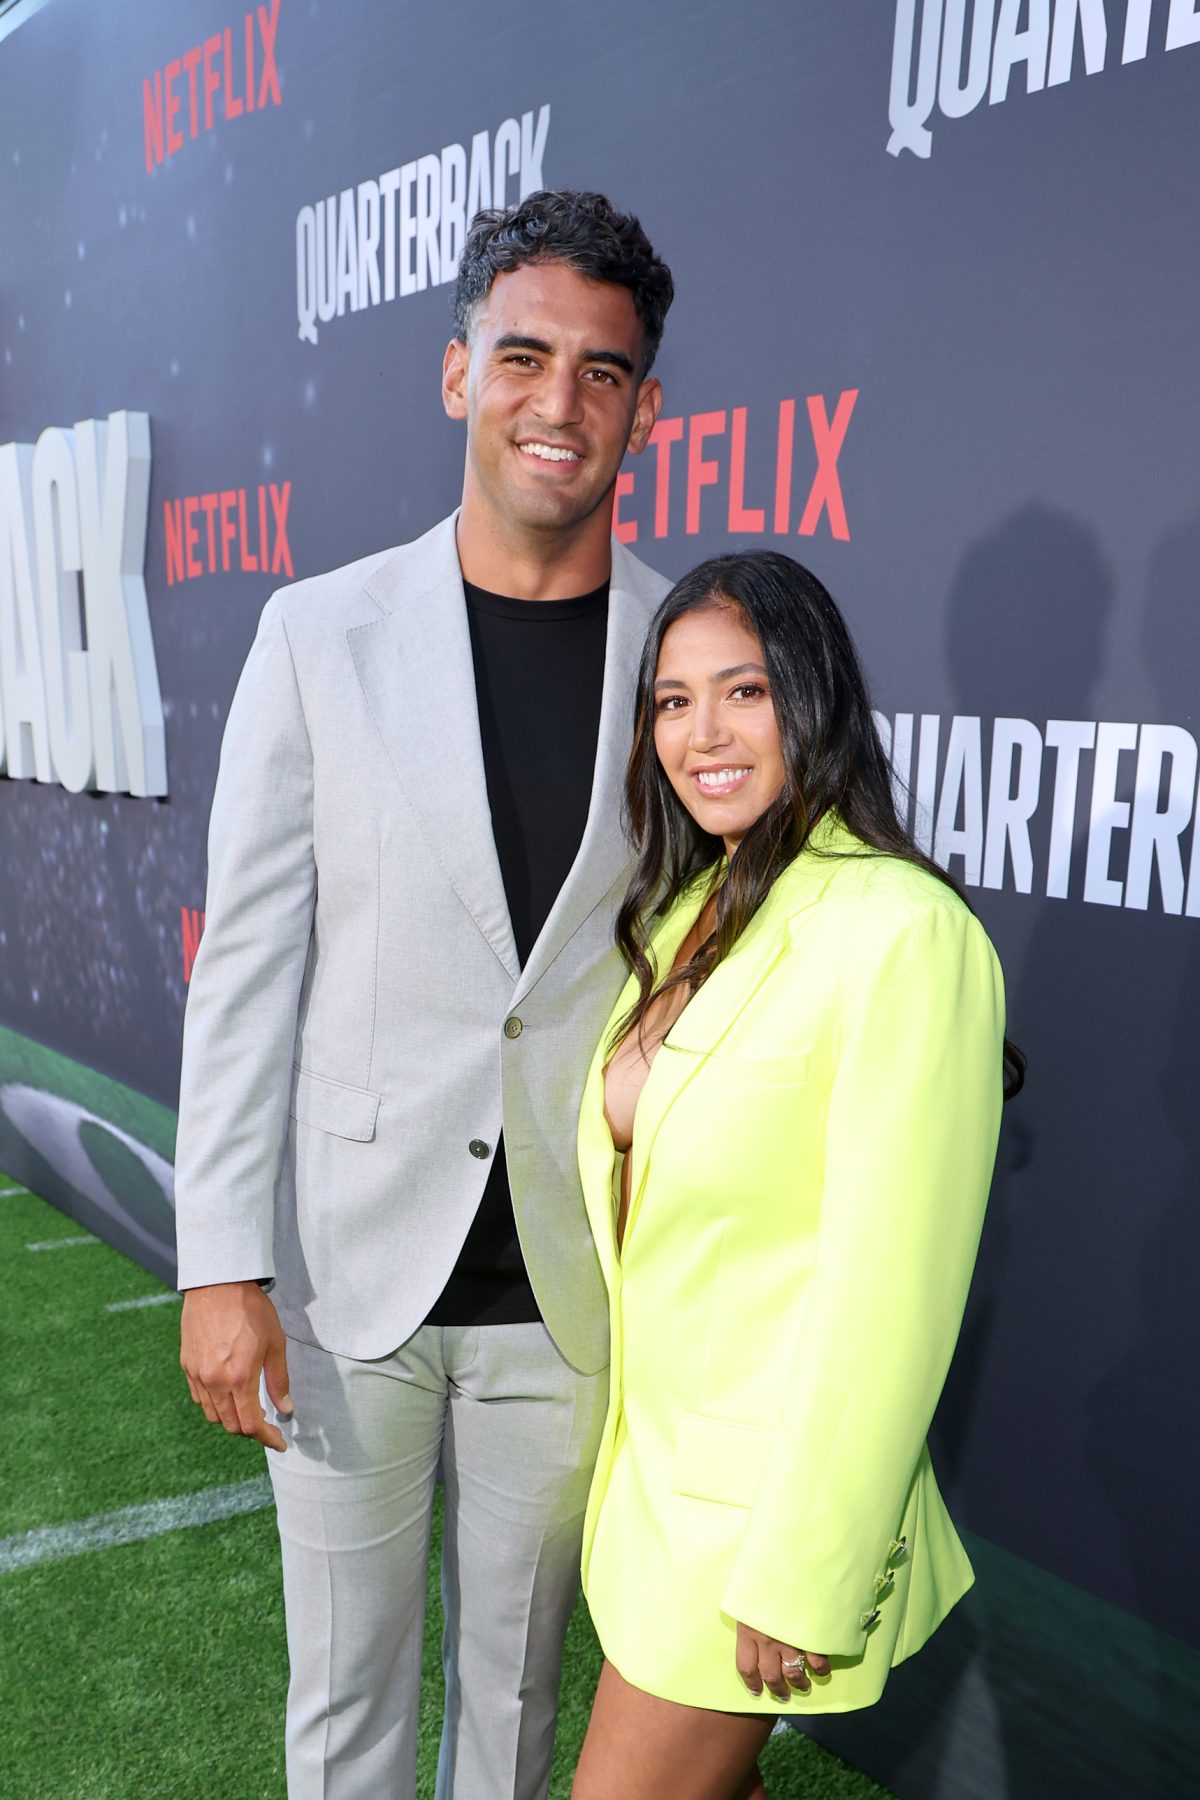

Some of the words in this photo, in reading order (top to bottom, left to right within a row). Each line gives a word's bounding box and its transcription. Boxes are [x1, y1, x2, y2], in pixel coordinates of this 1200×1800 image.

[143, 0, 282, 174] NETFLIX
[886, 0, 1200, 159] QUA
[296, 103, 550, 345] QUARTERBACK
[164, 481, 295, 586] NETFLIX
[611, 389, 859, 544] ETFLIX
[0, 409, 168, 798] ACK
[871, 710, 1200, 918] UARTER
